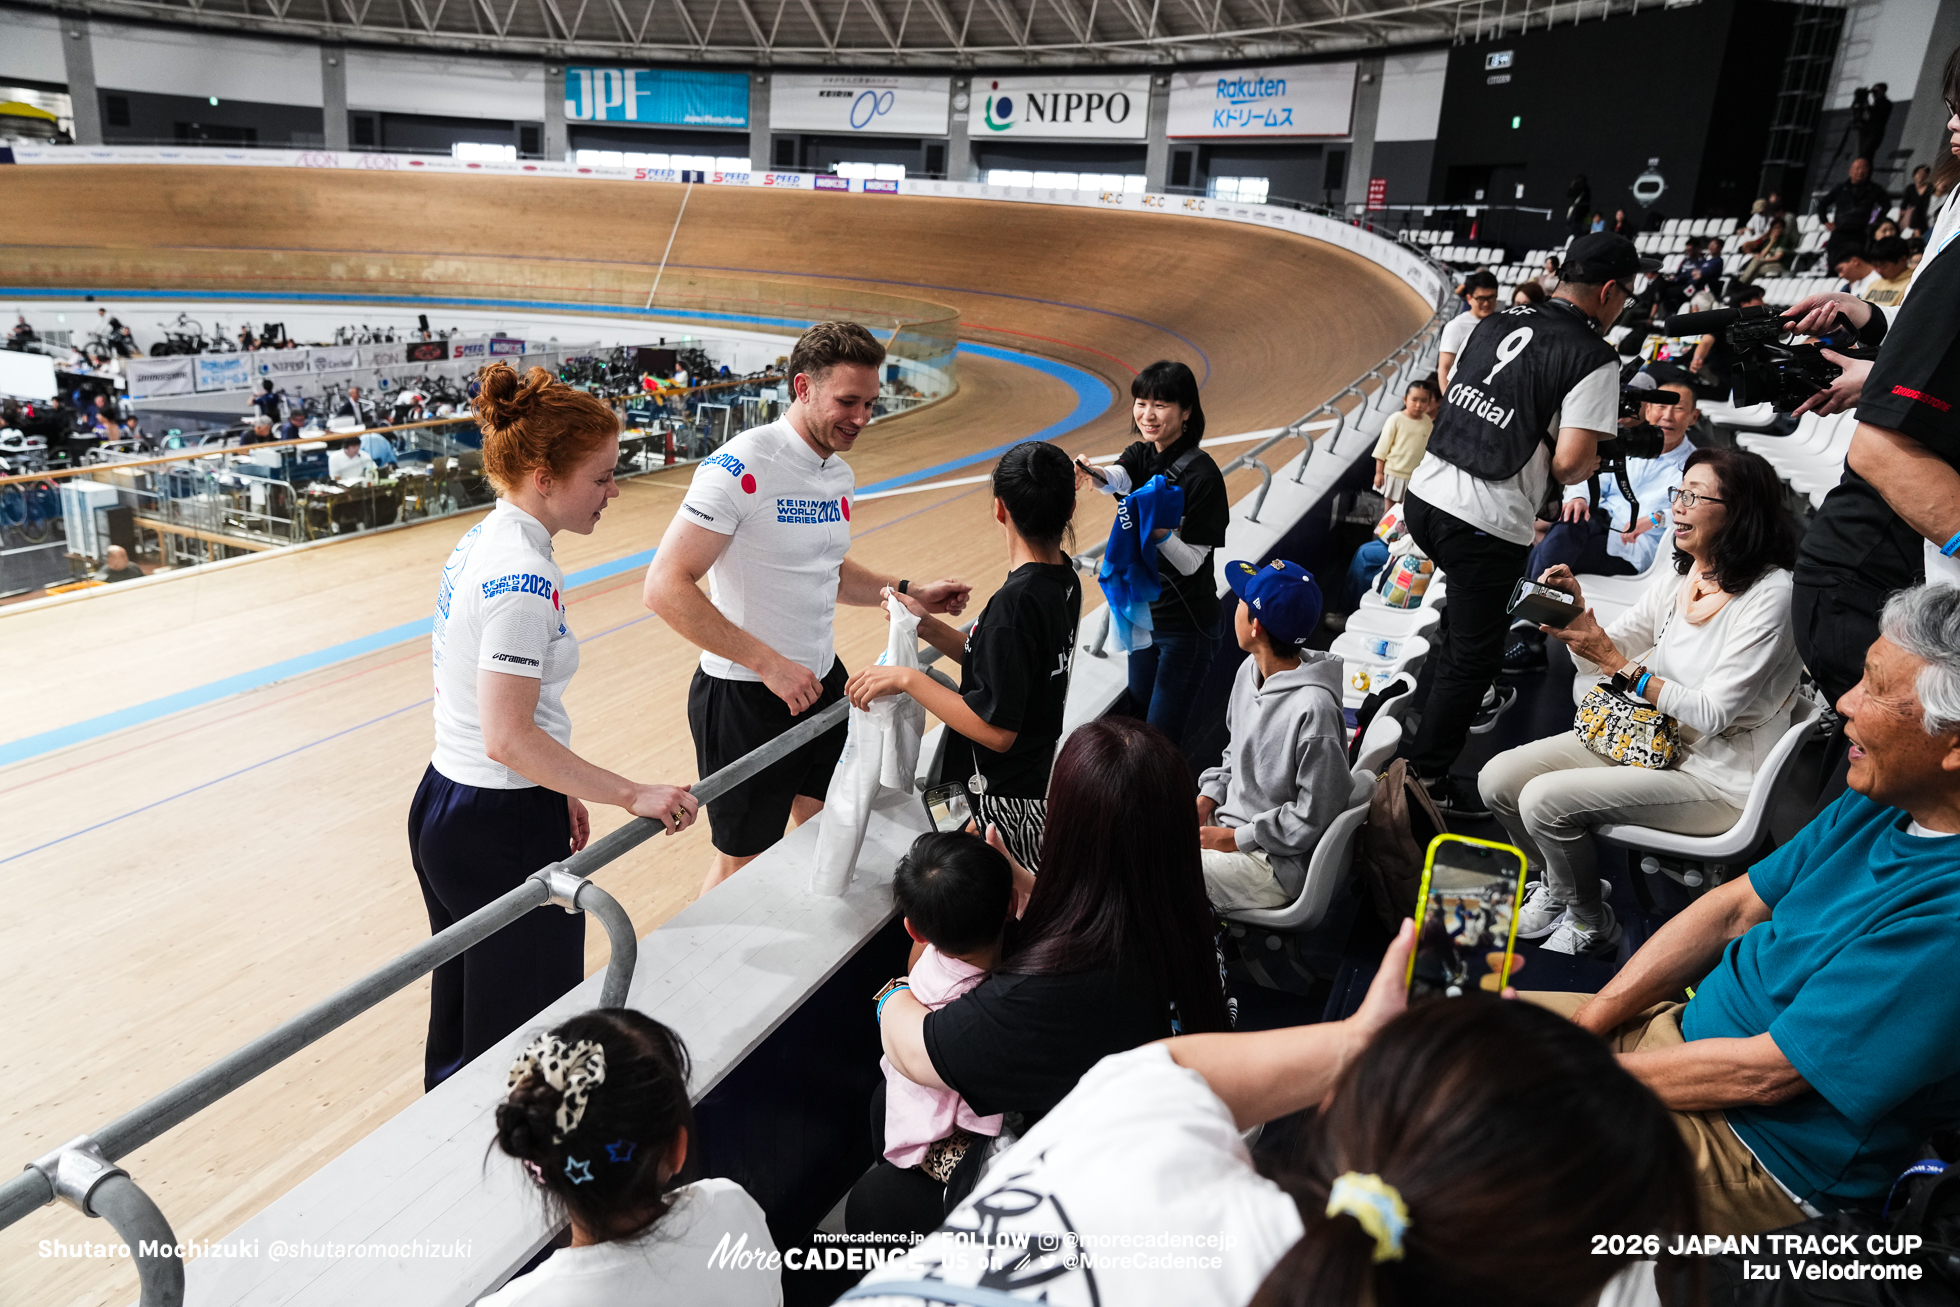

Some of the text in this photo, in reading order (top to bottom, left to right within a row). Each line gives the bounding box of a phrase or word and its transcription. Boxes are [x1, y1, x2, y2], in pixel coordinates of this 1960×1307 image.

[564, 69, 651, 121] JPF
[818, 90, 854, 98] KEIRIN
[1216, 76, 1286, 99] Rakuten
[1025, 92, 1130, 123] NIPPO
[1212, 107, 1293, 128] Kドリームス
[712, 171, 750, 183] SPEED
[763, 174, 801, 185] SPEED
[1482, 326, 1534, 385] 9
[1890, 384, 1952, 412] BRIDGESTONE
[716, 453, 746, 478] 2026
[1620, 480, 1637, 504] SONY
[776, 498, 819, 509] KEIRIN
[776, 506, 817, 516] WORLD
[1117, 498, 1133, 530] 2020
[776, 515, 818, 524] SERIES
[482, 573, 520, 590] KEIRIN
[483, 580, 520, 595] WORLD
[520, 573, 552, 600] 2026
